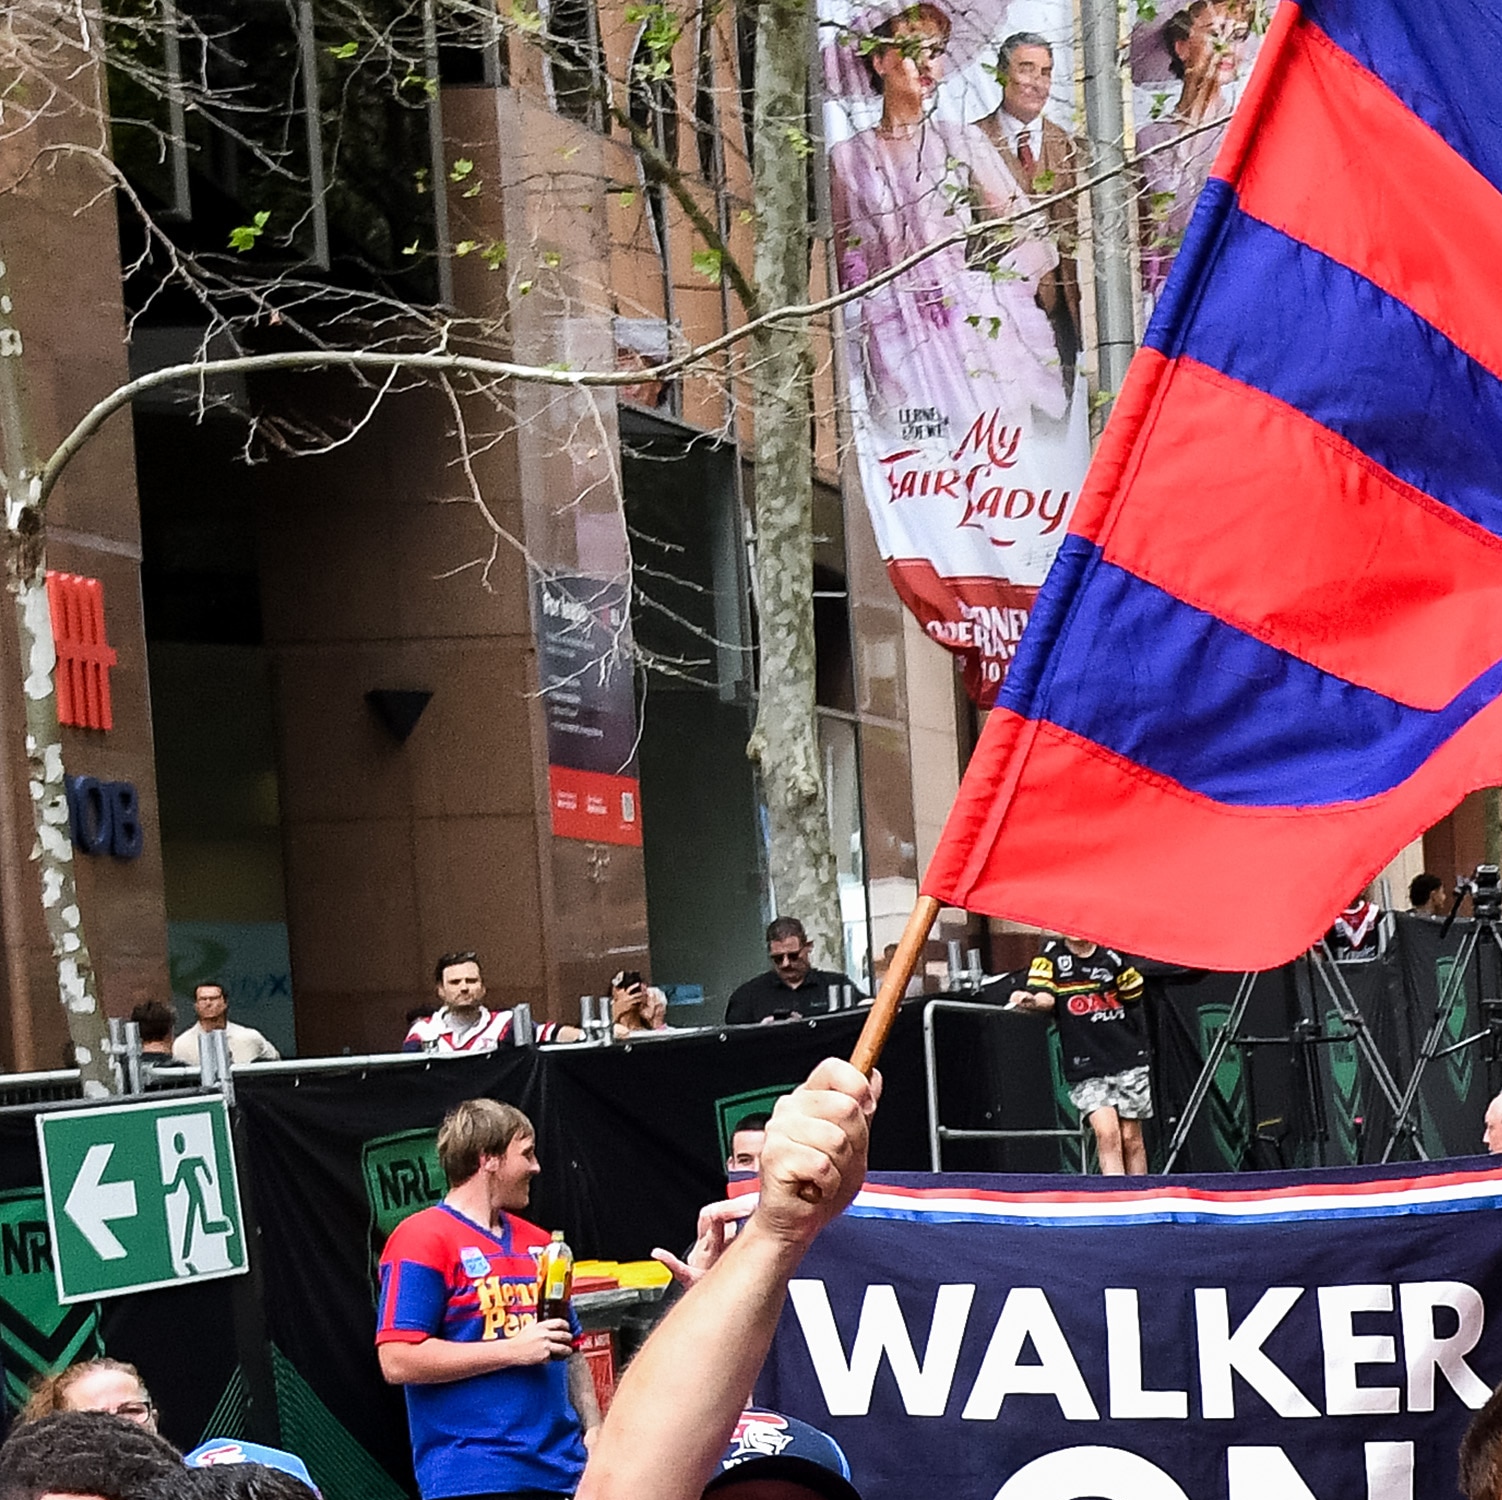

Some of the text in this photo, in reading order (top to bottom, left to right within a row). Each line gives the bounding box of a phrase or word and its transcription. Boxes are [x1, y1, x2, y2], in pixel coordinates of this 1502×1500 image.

[951, 407, 1023, 468] My
[878, 449, 1071, 535] FAIR LADY
[66, 775, 144, 862] OB
[376, 1156, 442, 1211] NRL
[1, 1220, 56, 1276] NR
